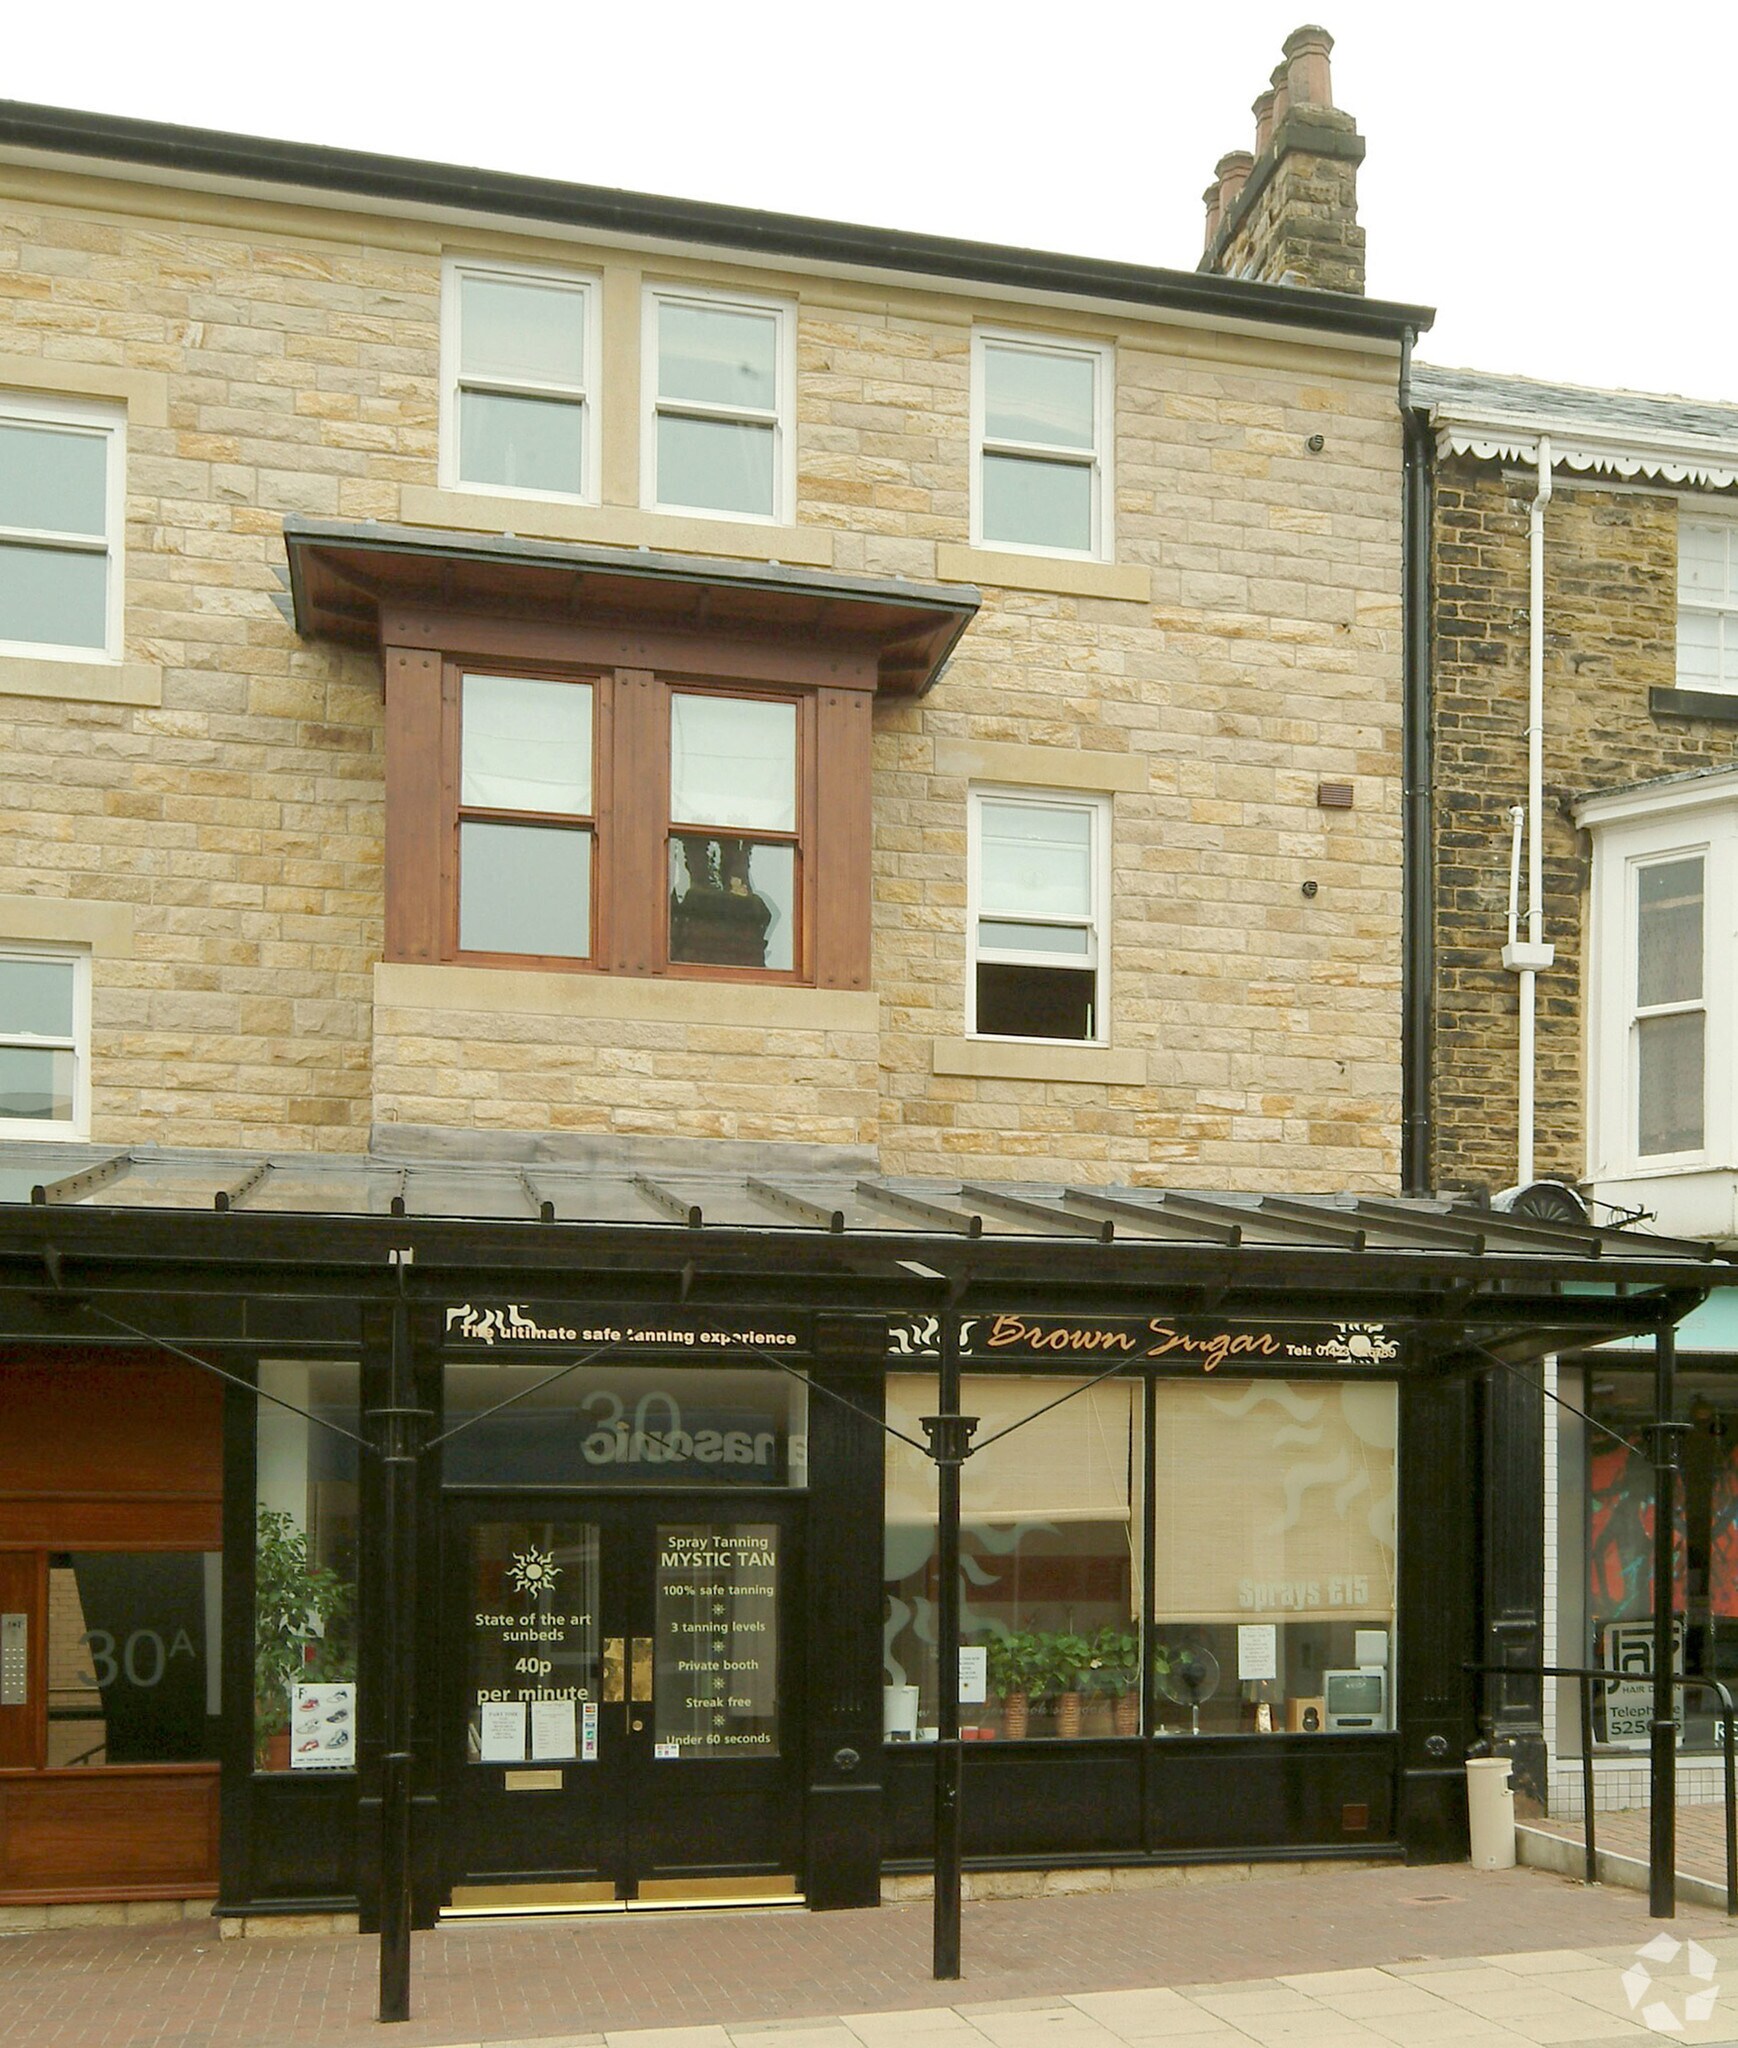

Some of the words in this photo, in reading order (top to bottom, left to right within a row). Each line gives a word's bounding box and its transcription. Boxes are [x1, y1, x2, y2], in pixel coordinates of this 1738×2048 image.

[499, 1326, 577, 1340] ultimate
[582, 1328, 621, 1341] safe
[627, 1328, 695, 1345] tanning
[700, 1330, 797, 1346] experience
[988, 1314, 1136, 1349] Brown
[1148, 1317, 1280, 1372] Sugar
[1286, 1344, 1312, 1356] Tel:
[581, 1391, 681, 1464] 30
[668, 1536, 707, 1550] Spray
[713, 1536, 768, 1550] Tanning
[661, 1552, 731, 1567] MYSTIC
[737, 1552, 776, 1567] TAN
[663, 1585, 695, 1596] 100%
[700, 1585, 724, 1596] safe
[729, 1585, 774, 1599] tanning
[1238, 1578, 1321, 1612] Sprays
[476, 1613, 513, 1626] State
[519, 1613, 534, 1626] of
[539, 1613, 564, 1626] the
[569, 1613, 592, 1626] art
[502, 1628, 565, 1641] sunbeds
[671, 1621, 678, 1633] 3
[683, 1621, 729, 1635] tanning
[732, 1621, 766, 1633] levels
[515, 1657, 552, 1677] 40p
[678, 1660, 719, 1671] Private
[724, 1660, 759, 1671] booth
[477, 1688, 510, 1703] per
[517, 1684, 589, 1702] minute
[1622, 1685, 1645, 1694] HAIR
[686, 1697, 722, 1708] Streak
[727, 1697, 752, 1708] free
[666, 1734, 701, 1746] Under
[706, 1734, 720, 1745] 60
[724, 1733, 771, 1745] seconds
